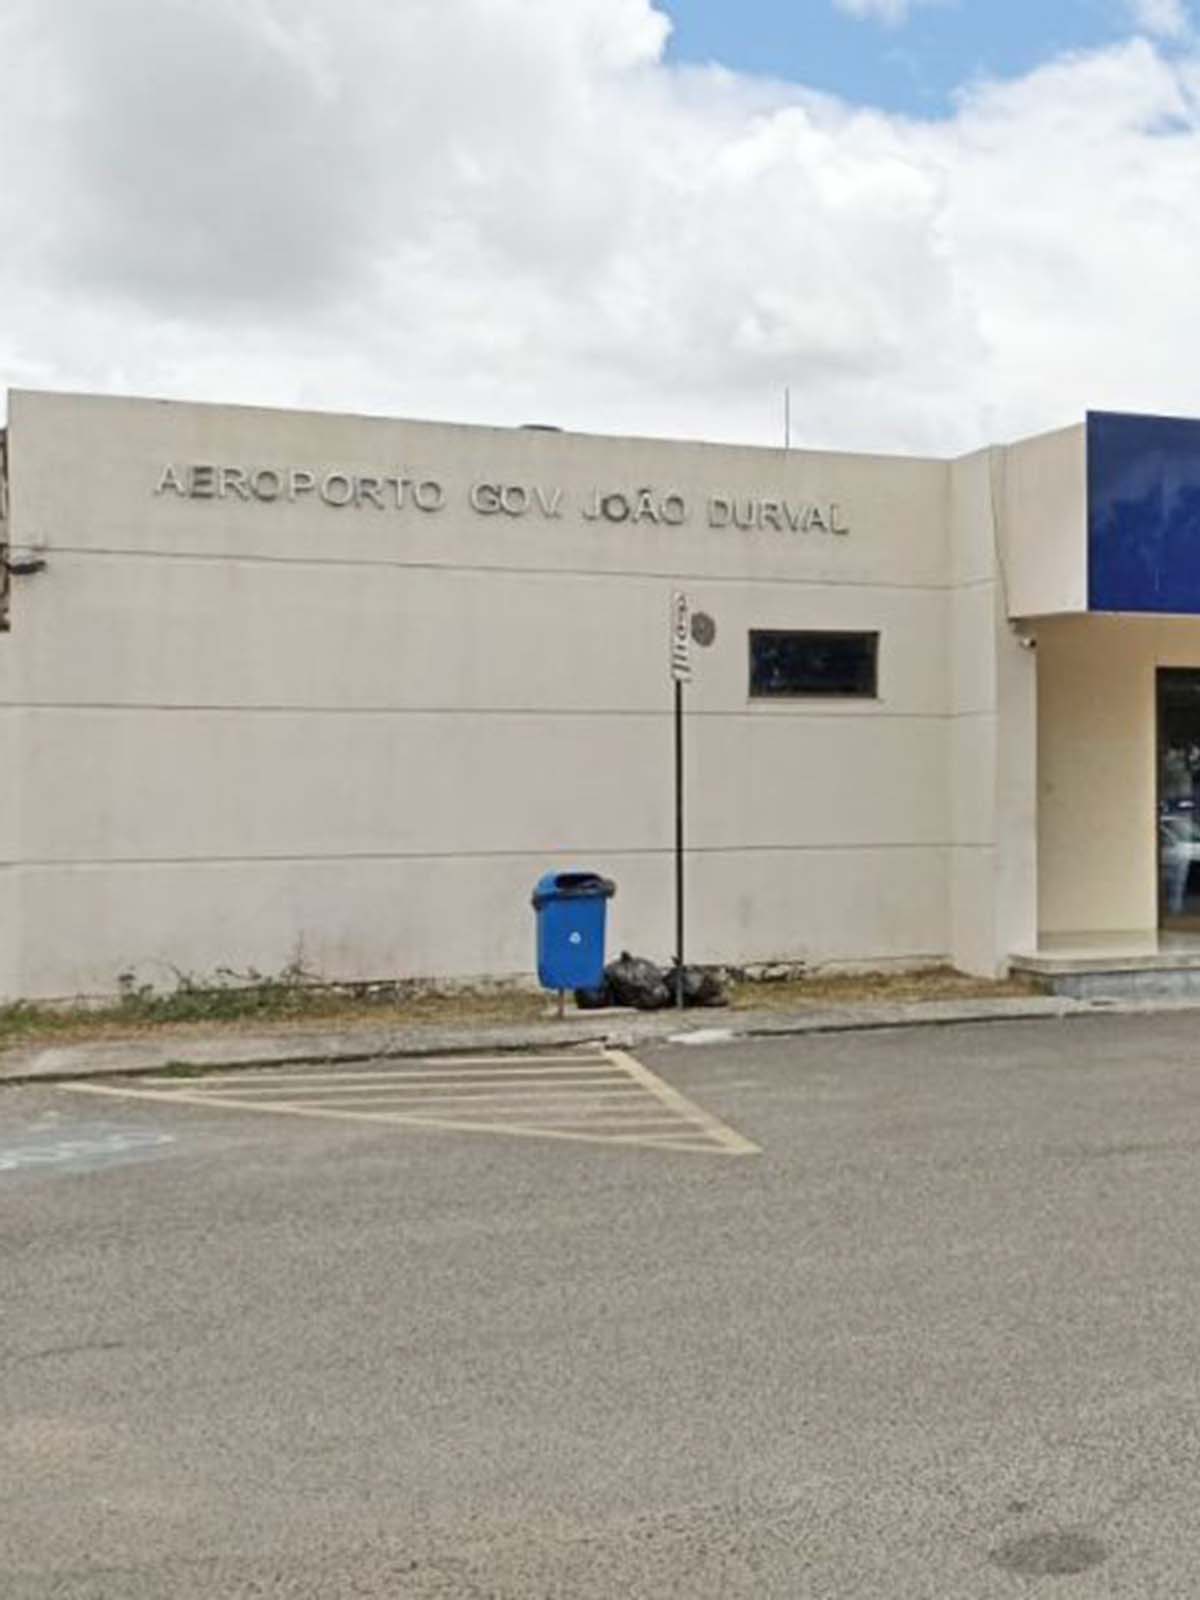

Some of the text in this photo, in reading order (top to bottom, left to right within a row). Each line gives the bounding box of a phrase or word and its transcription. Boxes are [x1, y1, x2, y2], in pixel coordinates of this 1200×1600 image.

[154, 463, 446, 512] AEROPORTO
[581, 488, 688, 526] JOÃO
[707, 496, 850, 536] DURVAL
